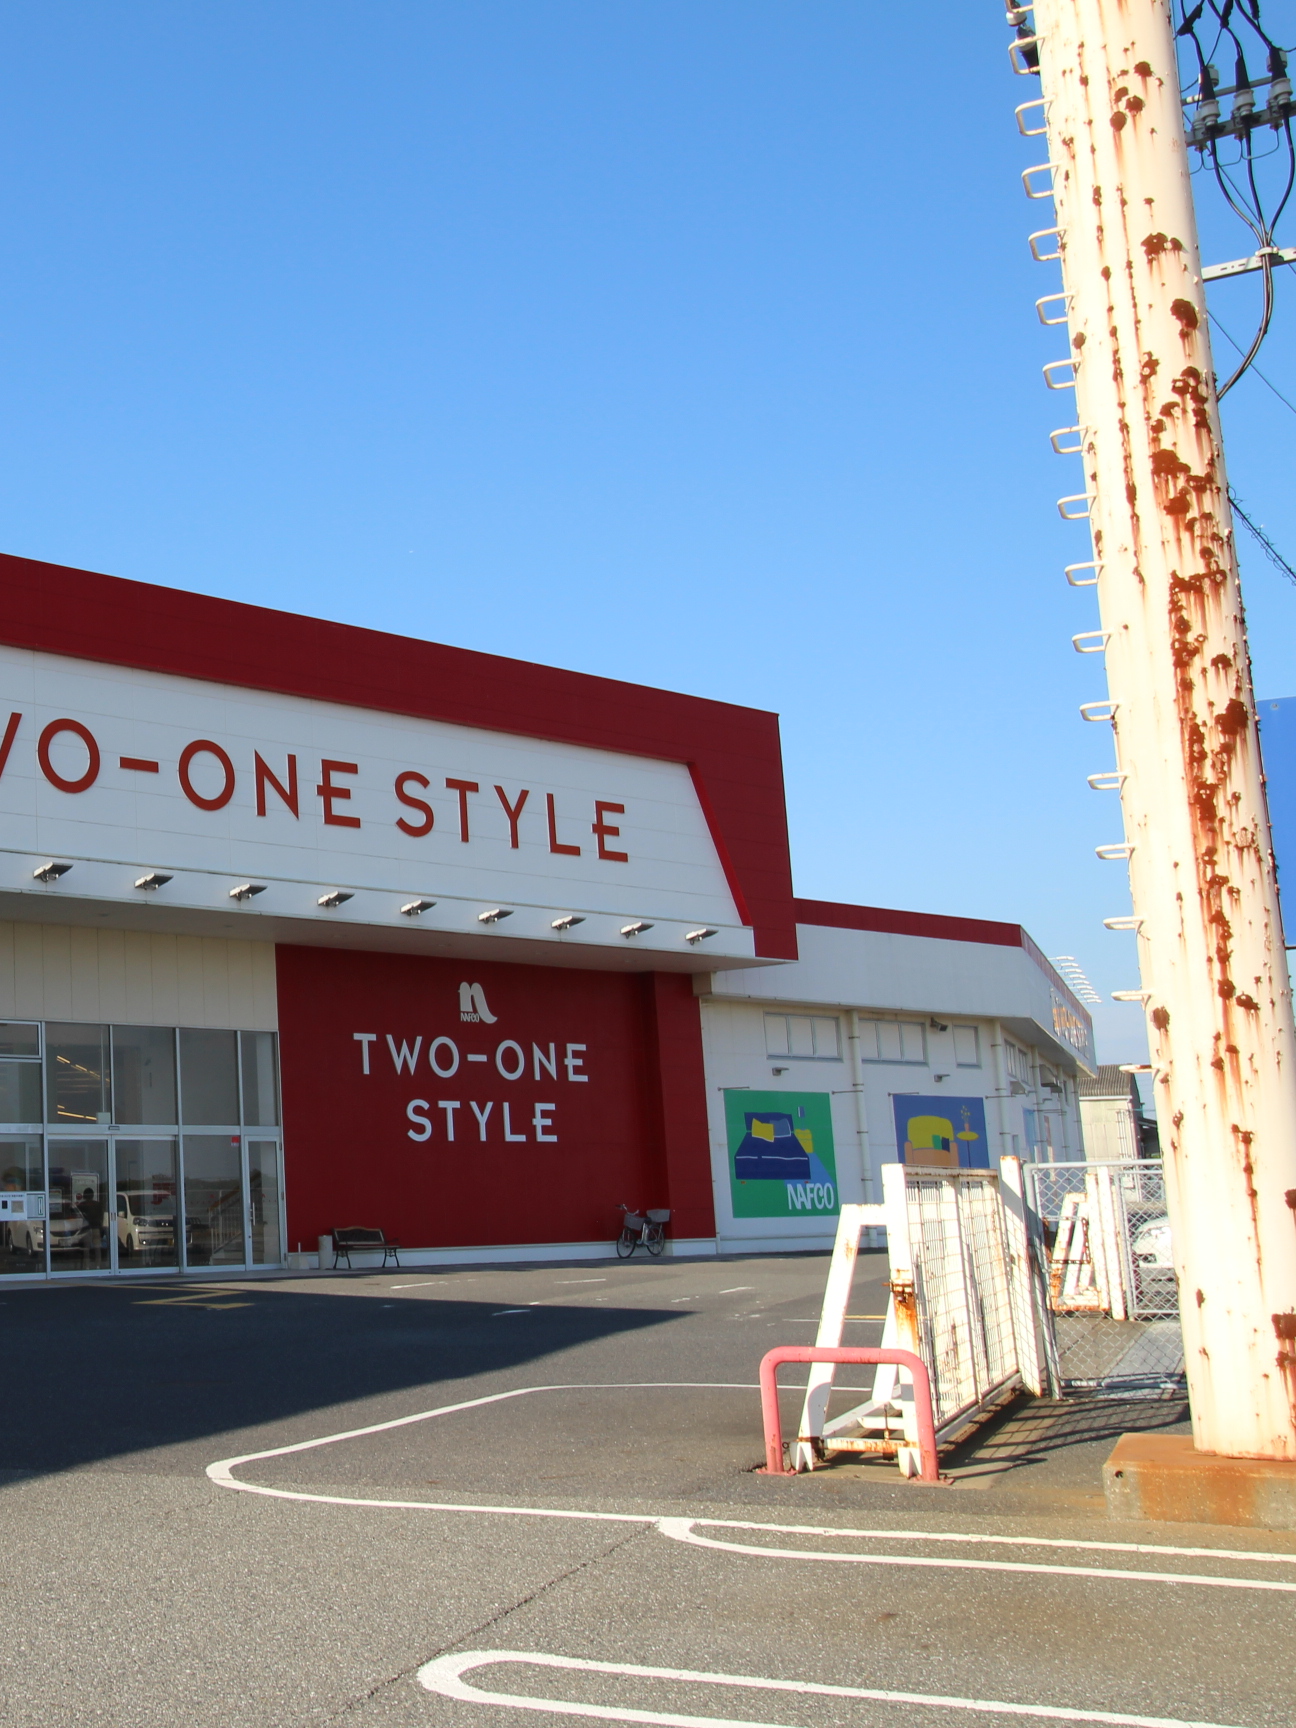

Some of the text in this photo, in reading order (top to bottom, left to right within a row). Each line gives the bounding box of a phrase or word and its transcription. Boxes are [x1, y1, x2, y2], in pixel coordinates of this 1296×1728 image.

[394, 770, 629, 863] STYLE
[460, 1012, 480, 1023] NAFCO
[353, 1033, 589, 1083] TWO-ONE
[406, 1099, 558, 1143] STYLE
[787, 1182, 834, 1210] NAFCO
